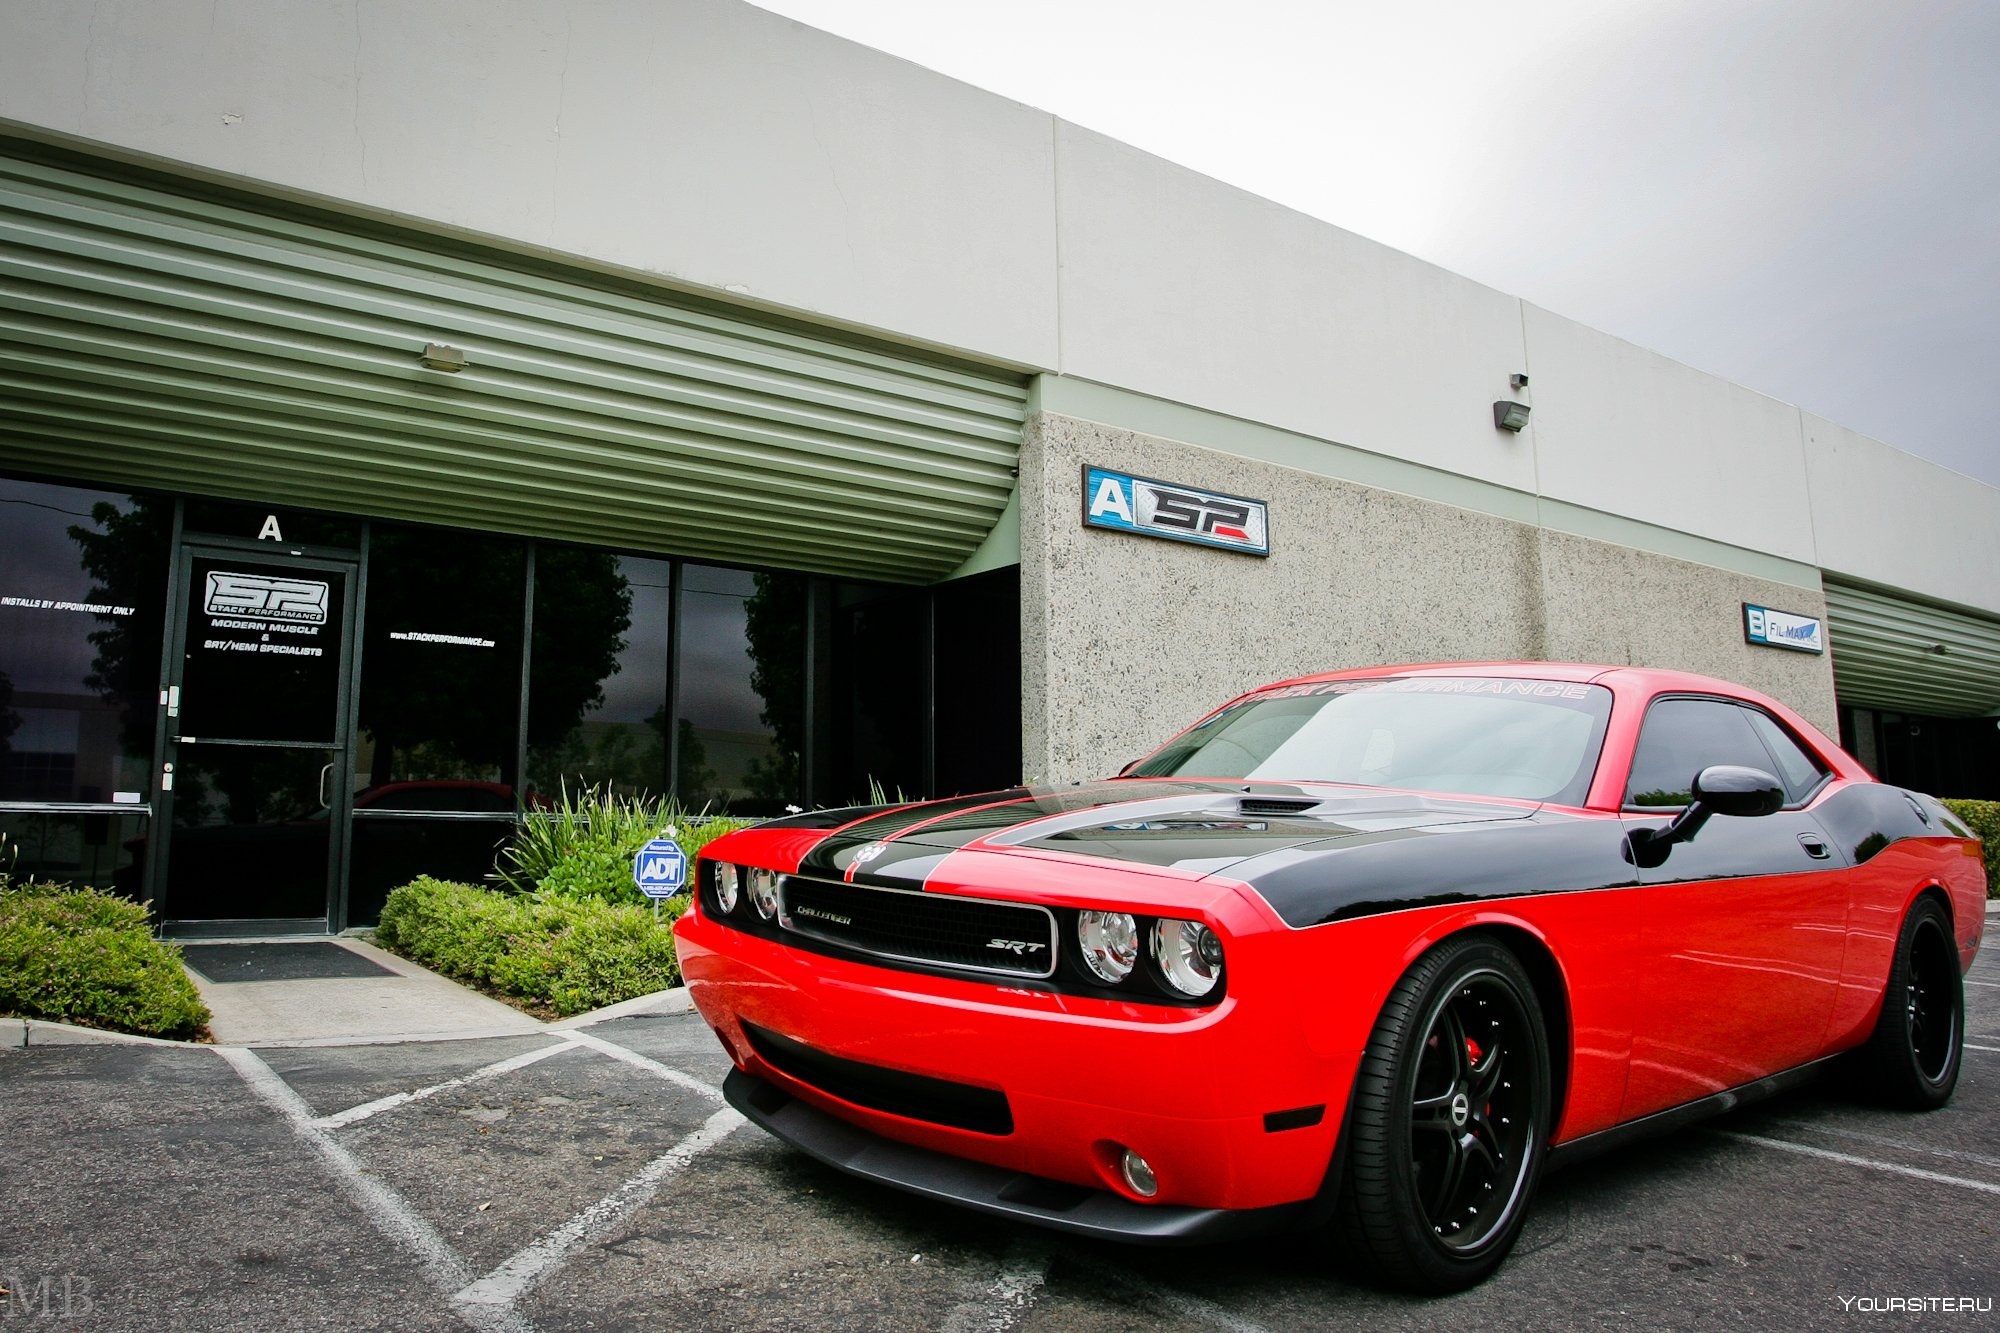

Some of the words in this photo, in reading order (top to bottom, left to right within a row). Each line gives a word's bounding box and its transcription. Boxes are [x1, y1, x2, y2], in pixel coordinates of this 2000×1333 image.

[1090, 477, 1134, 523] A
[257, 514, 283, 542] A
[1, 597, 41, 607] INSTALLS
[41, 600, 55, 609] BY
[54, 602, 113, 614] APPOINTMENT
[112, 606, 136, 616] ONLY
[209, 603, 246, 614] STACK
[248, 607, 323, 621] PERFORMANCE
[211, 619, 267, 631] MODERN
[269, 623, 319, 635] MUSCLE
[1748, 609, 1766, 637] B
[261, 633, 270, 642] &
[204, 640, 259, 652] SRT/HEMI
[260, 644, 323, 656] SPECIALISTS
[641, 857, 680, 881] ADT
[796, 905, 852, 925] CHALLENGER
[986, 938, 1046, 955] SRT
